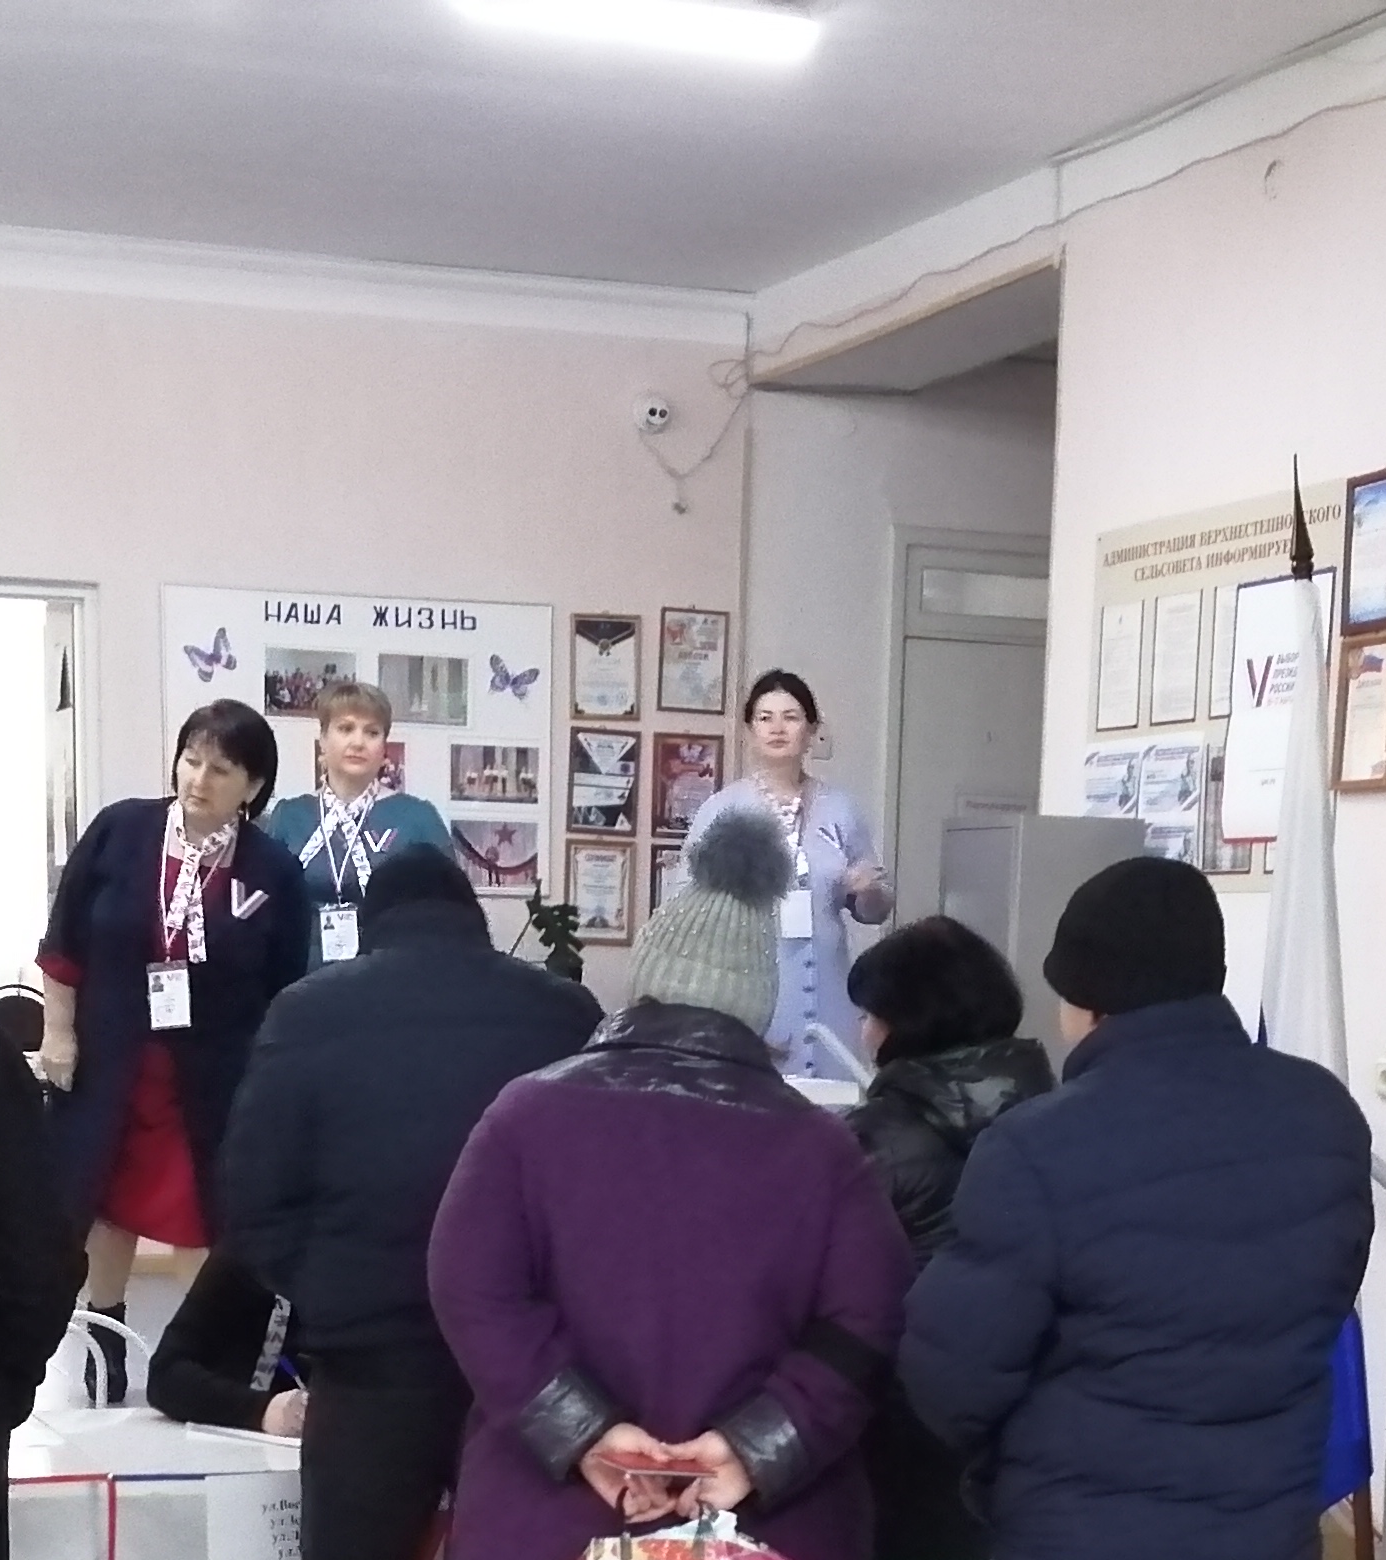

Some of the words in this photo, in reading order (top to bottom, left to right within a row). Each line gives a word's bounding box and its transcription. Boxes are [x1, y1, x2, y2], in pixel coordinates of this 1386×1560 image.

[1102, 533, 1197, 568] АДМИНИСТРАЦИЯ
[1199, 504, 1342, 547] ВЕРХНЕСТЕПНОКОГО
[1134, 557, 1203, 582] СЕЛЬСОВЕТА
[1205, 538, 1292, 569] ИНФОРМИРУЕ
[264, 600, 343, 626] НАША
[372, 605, 478, 632] ЖИЗНЬ
